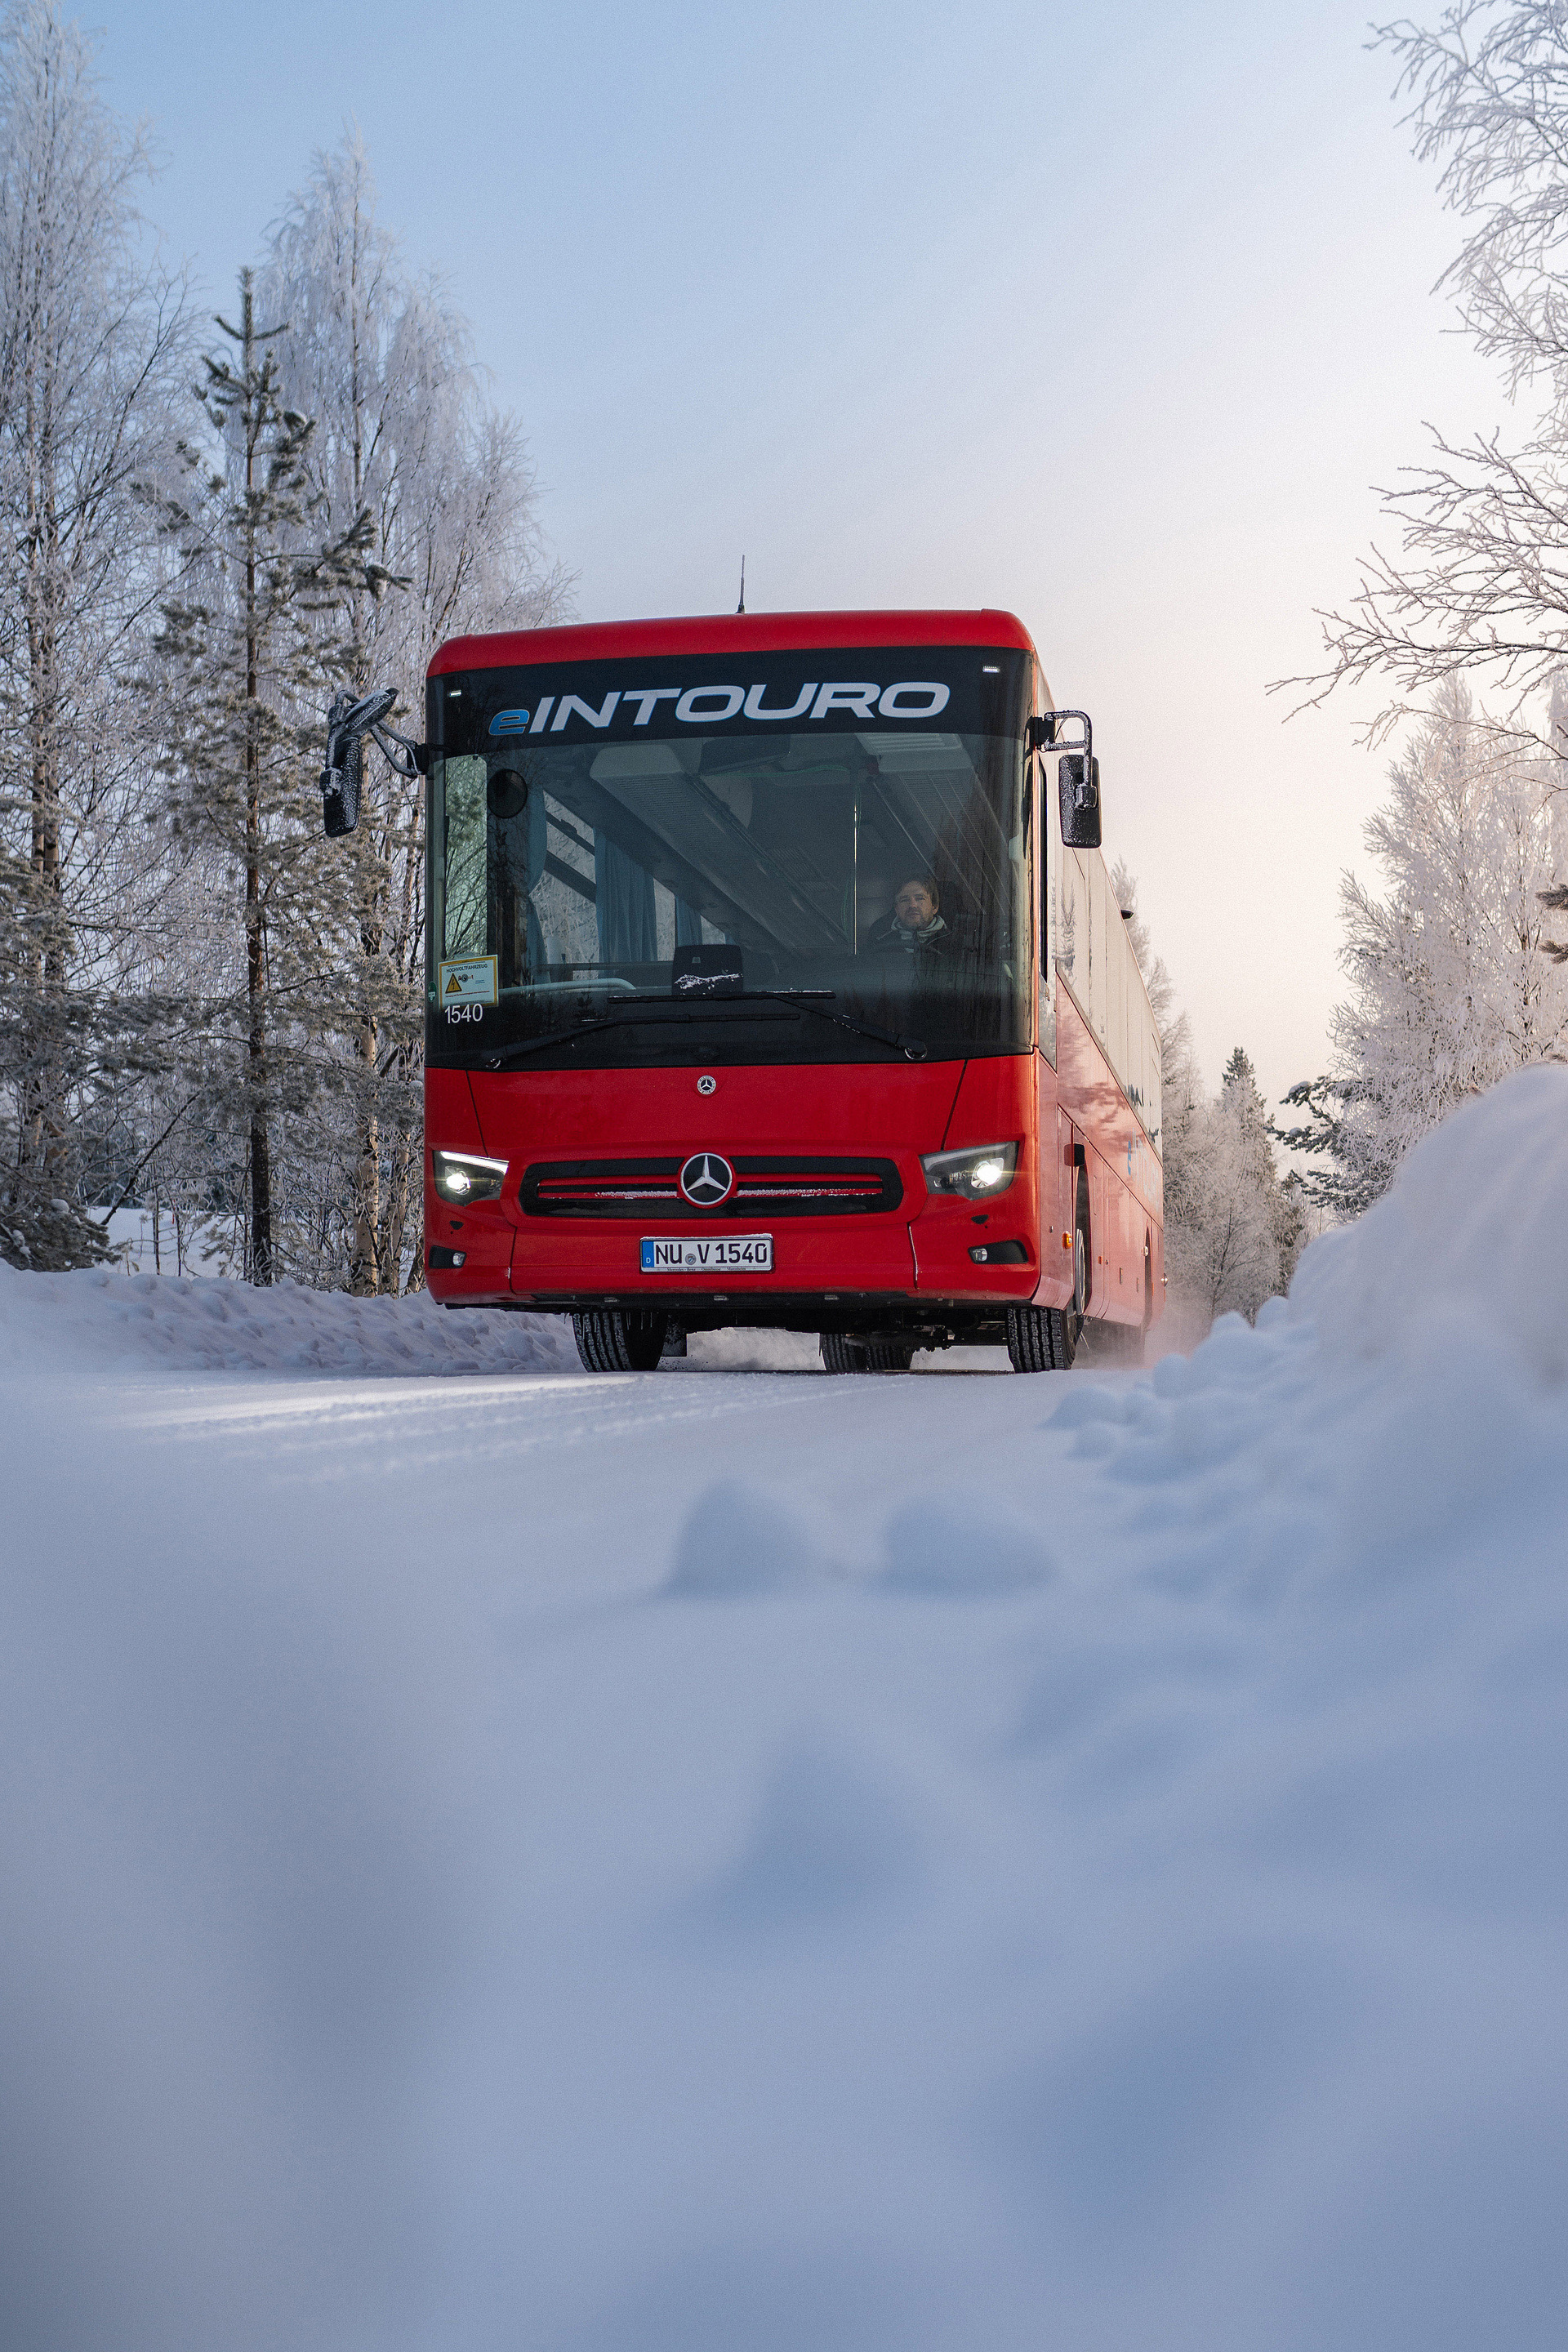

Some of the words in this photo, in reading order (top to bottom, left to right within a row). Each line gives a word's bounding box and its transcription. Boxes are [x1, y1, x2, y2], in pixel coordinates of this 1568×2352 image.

[488, 681, 951, 735] eINTOURO
[444, 1003, 483, 1024] 1540
[655, 1244, 683, 1265] NU
[697, 1243, 710, 1264] V
[715, 1243, 768, 1263] 1540
